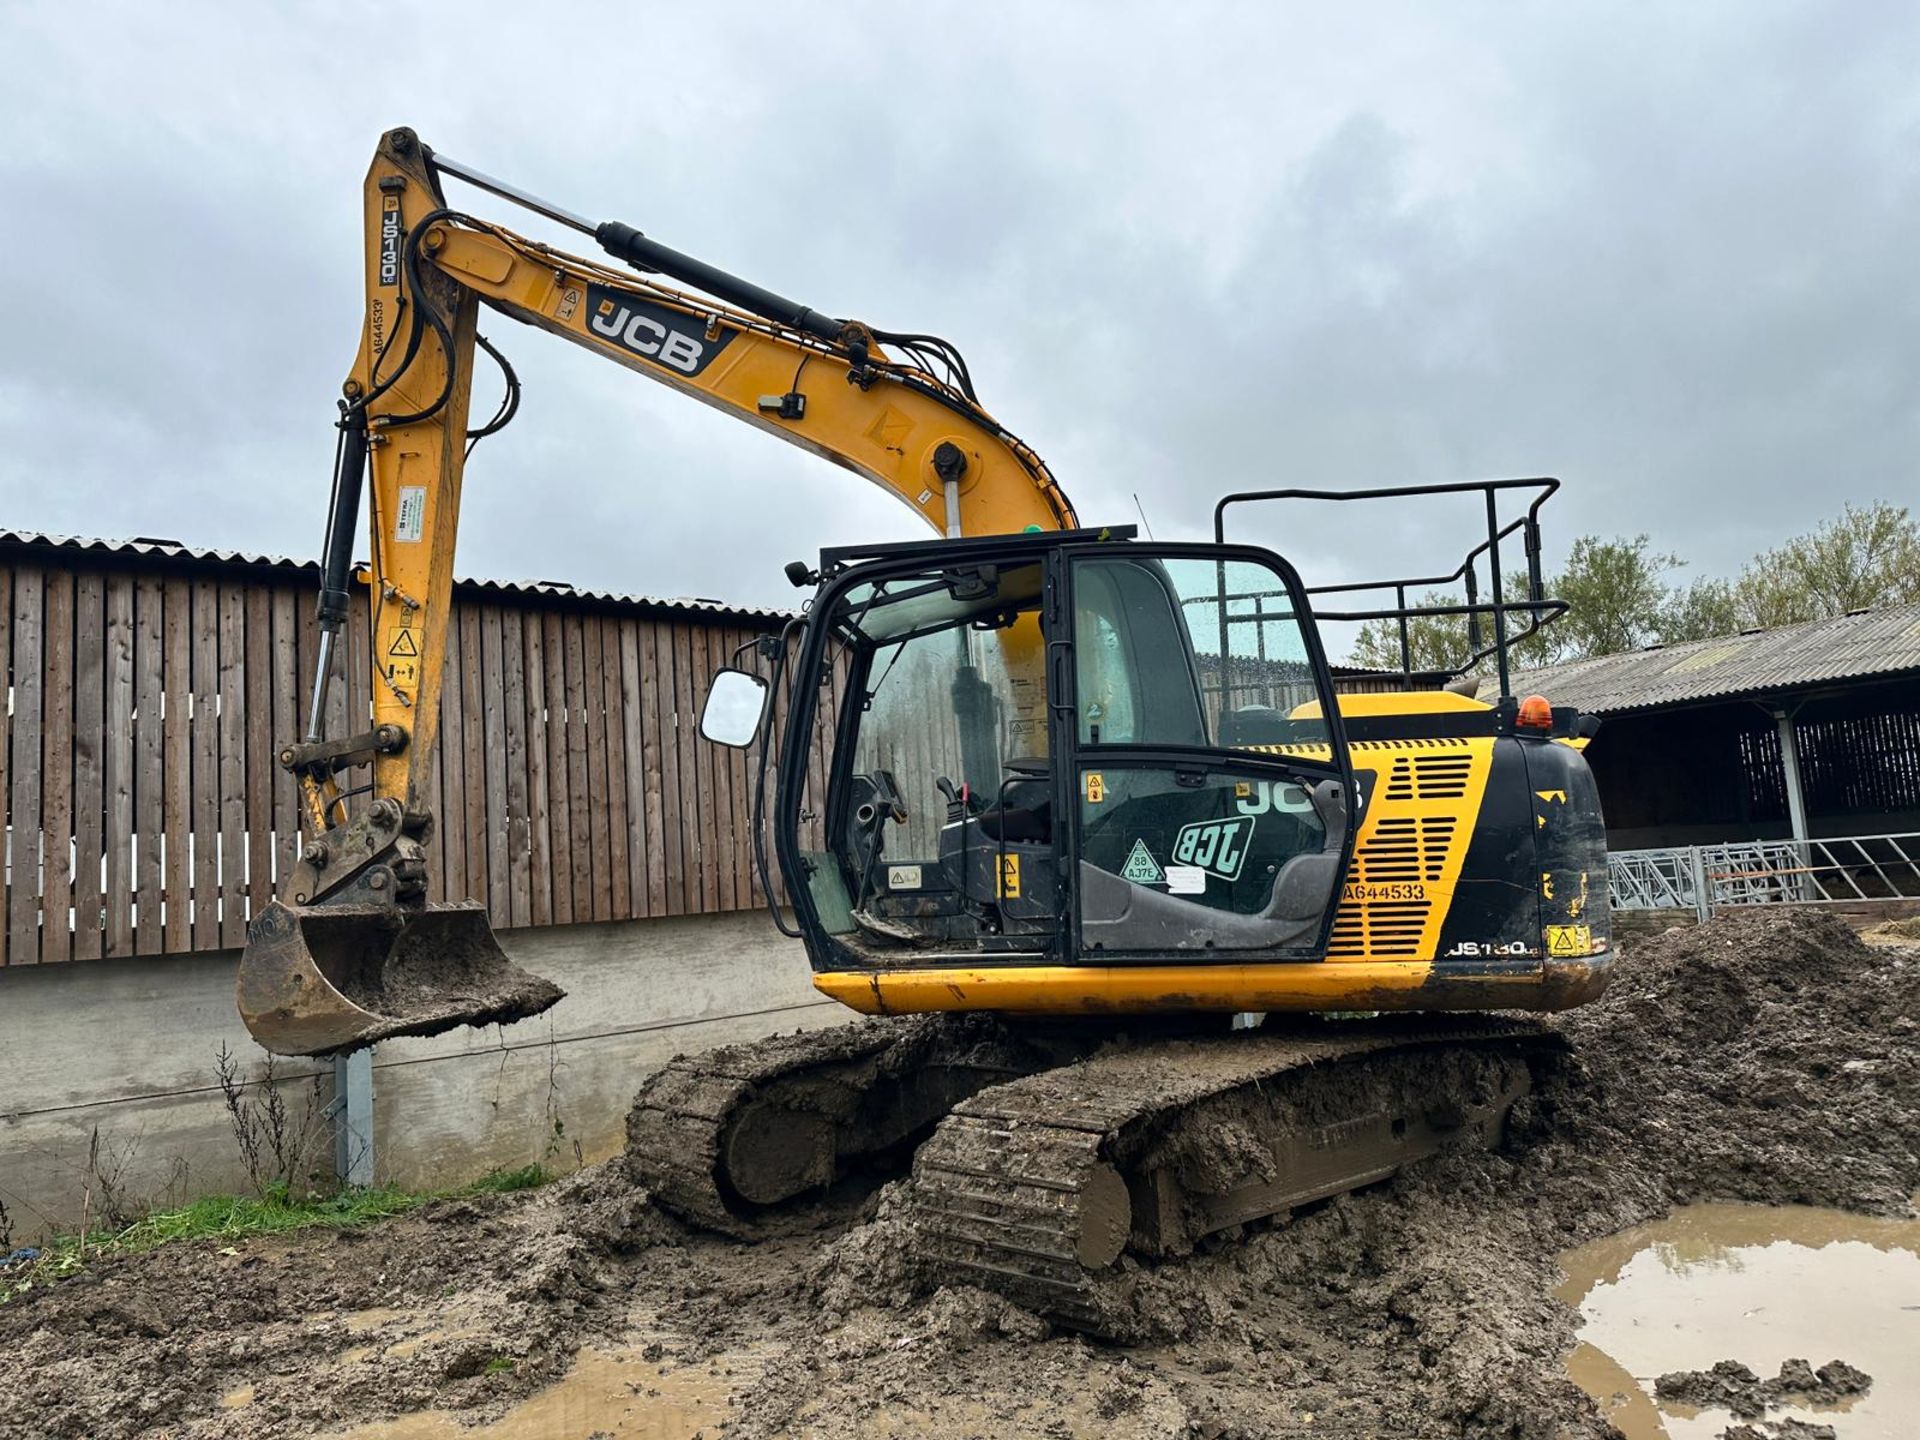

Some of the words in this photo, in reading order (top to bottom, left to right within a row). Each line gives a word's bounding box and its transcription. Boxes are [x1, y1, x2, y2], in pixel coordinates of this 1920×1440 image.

[381, 212, 397, 277] JS130
[592, 307, 704, 373] JCB
[1343, 884, 1425, 900] A644533
